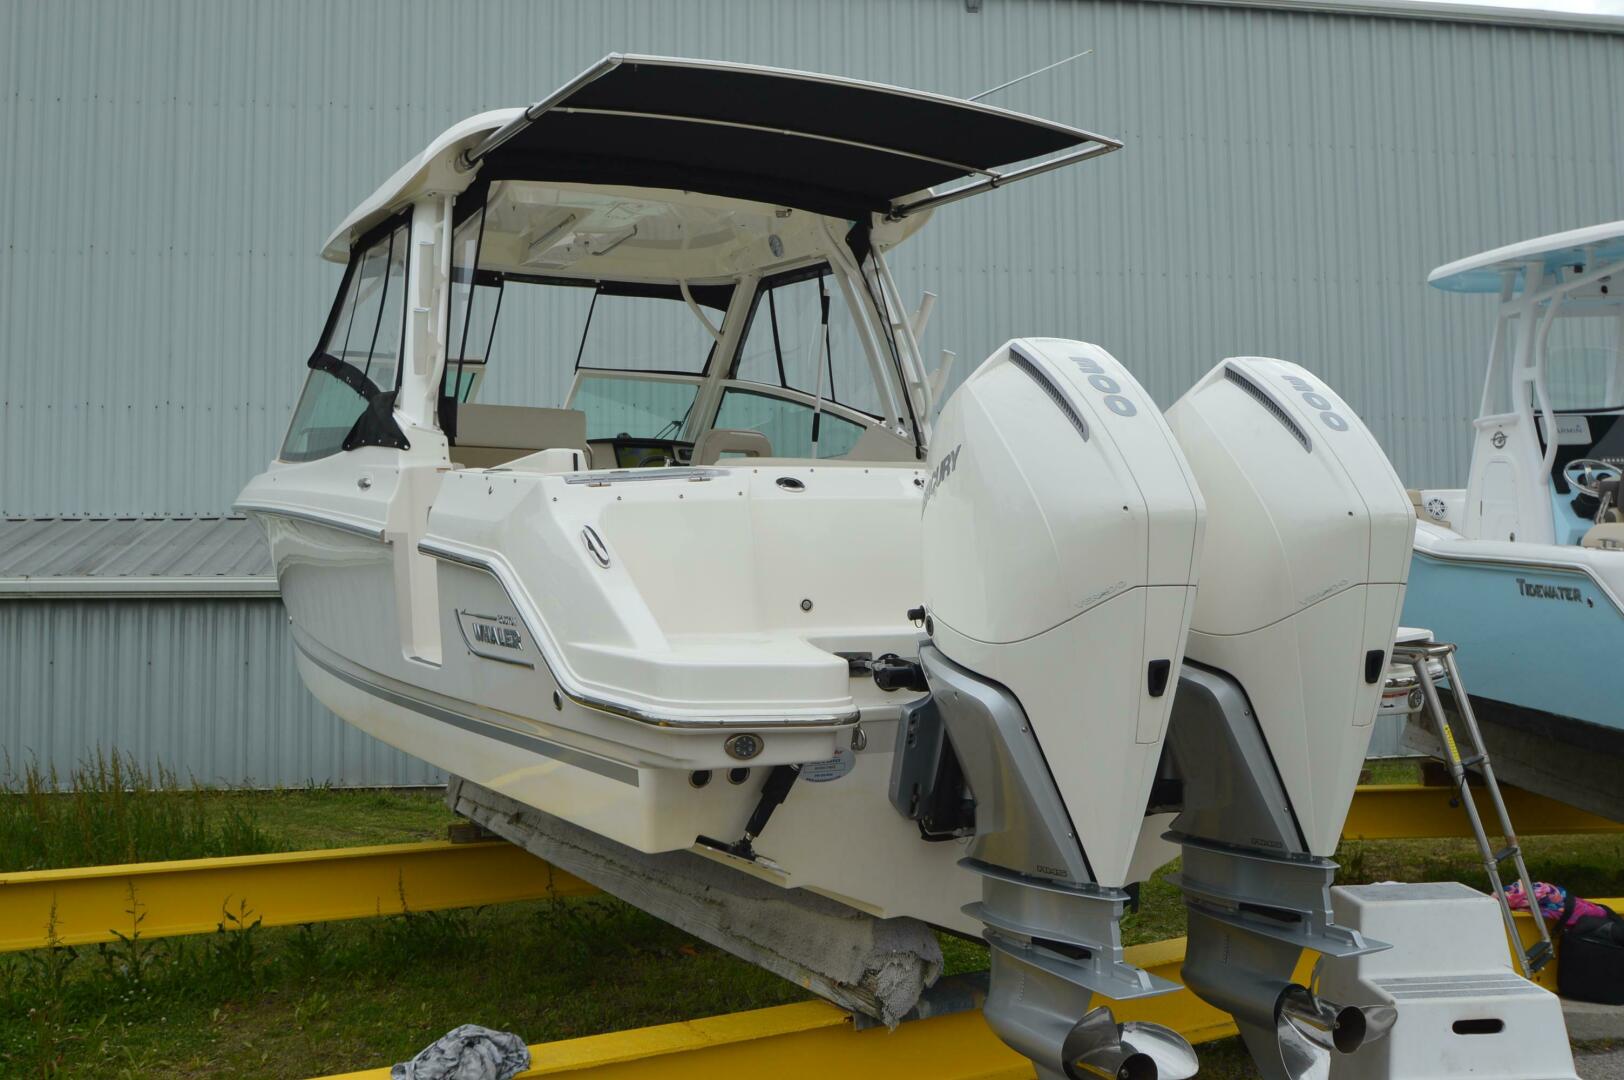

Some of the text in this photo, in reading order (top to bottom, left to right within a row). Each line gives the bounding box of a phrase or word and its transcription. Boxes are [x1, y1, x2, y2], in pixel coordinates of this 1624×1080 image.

[1068, 356, 1138, 418] 300
[1281, 375, 1349, 432] 300
[1516, 577, 1582, 603] TIDEWATER
[473, 623, 522, 650] WHALER
